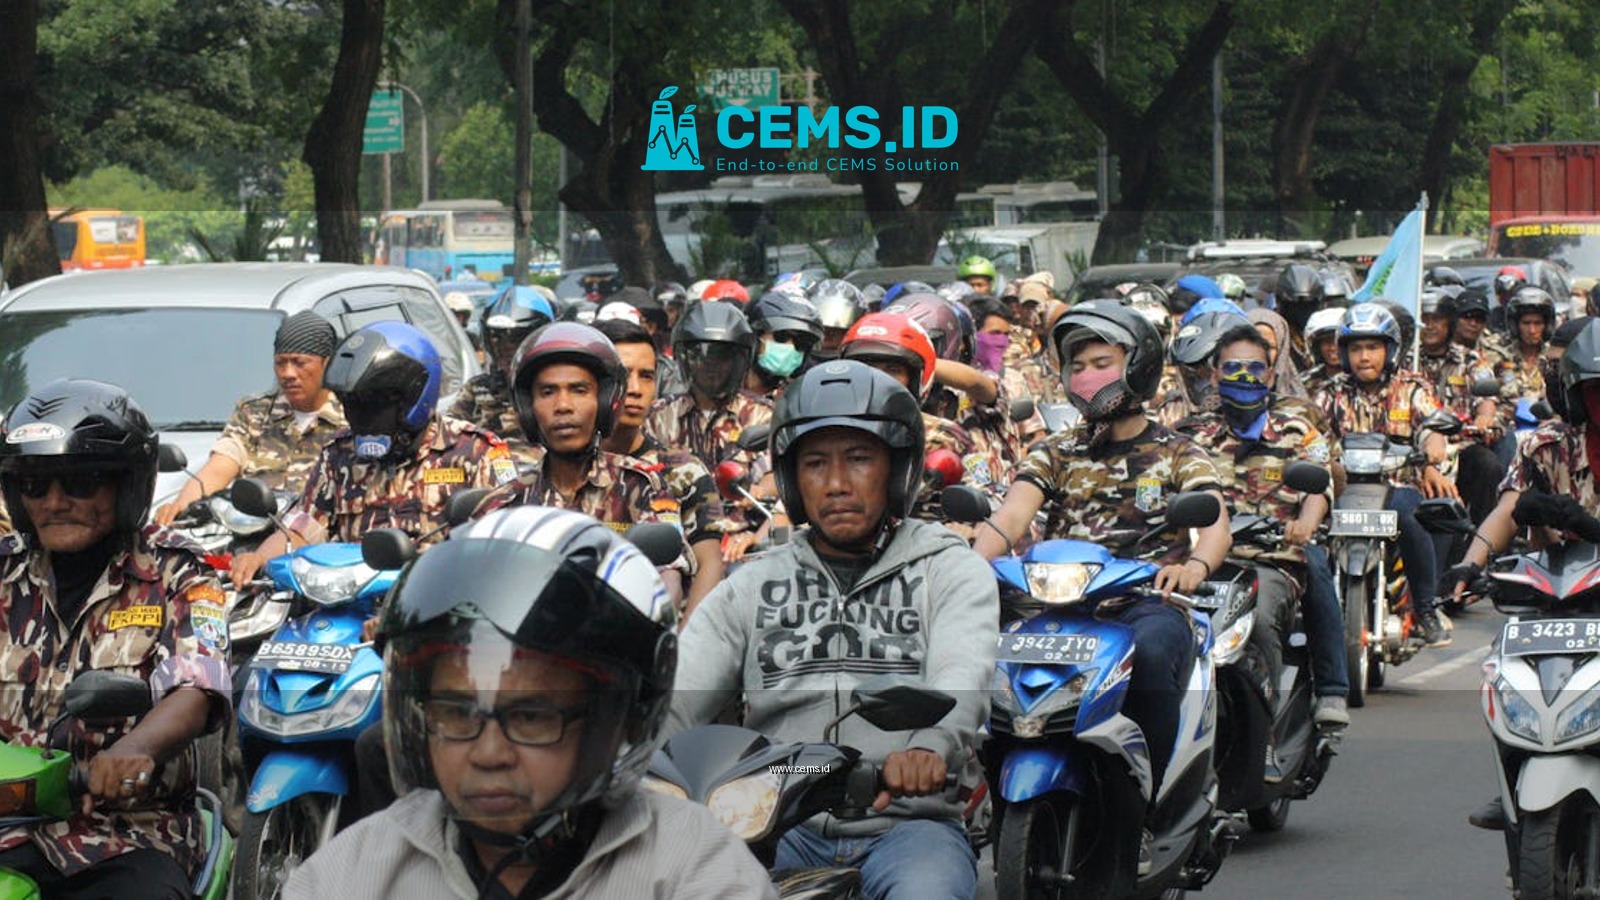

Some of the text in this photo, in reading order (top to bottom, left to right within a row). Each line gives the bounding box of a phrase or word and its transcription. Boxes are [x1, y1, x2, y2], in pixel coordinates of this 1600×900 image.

[761, 570, 829, 607] OH
[756, 598, 919, 634] FUCKING
[1508, 623, 1600, 639] B 3423 B
